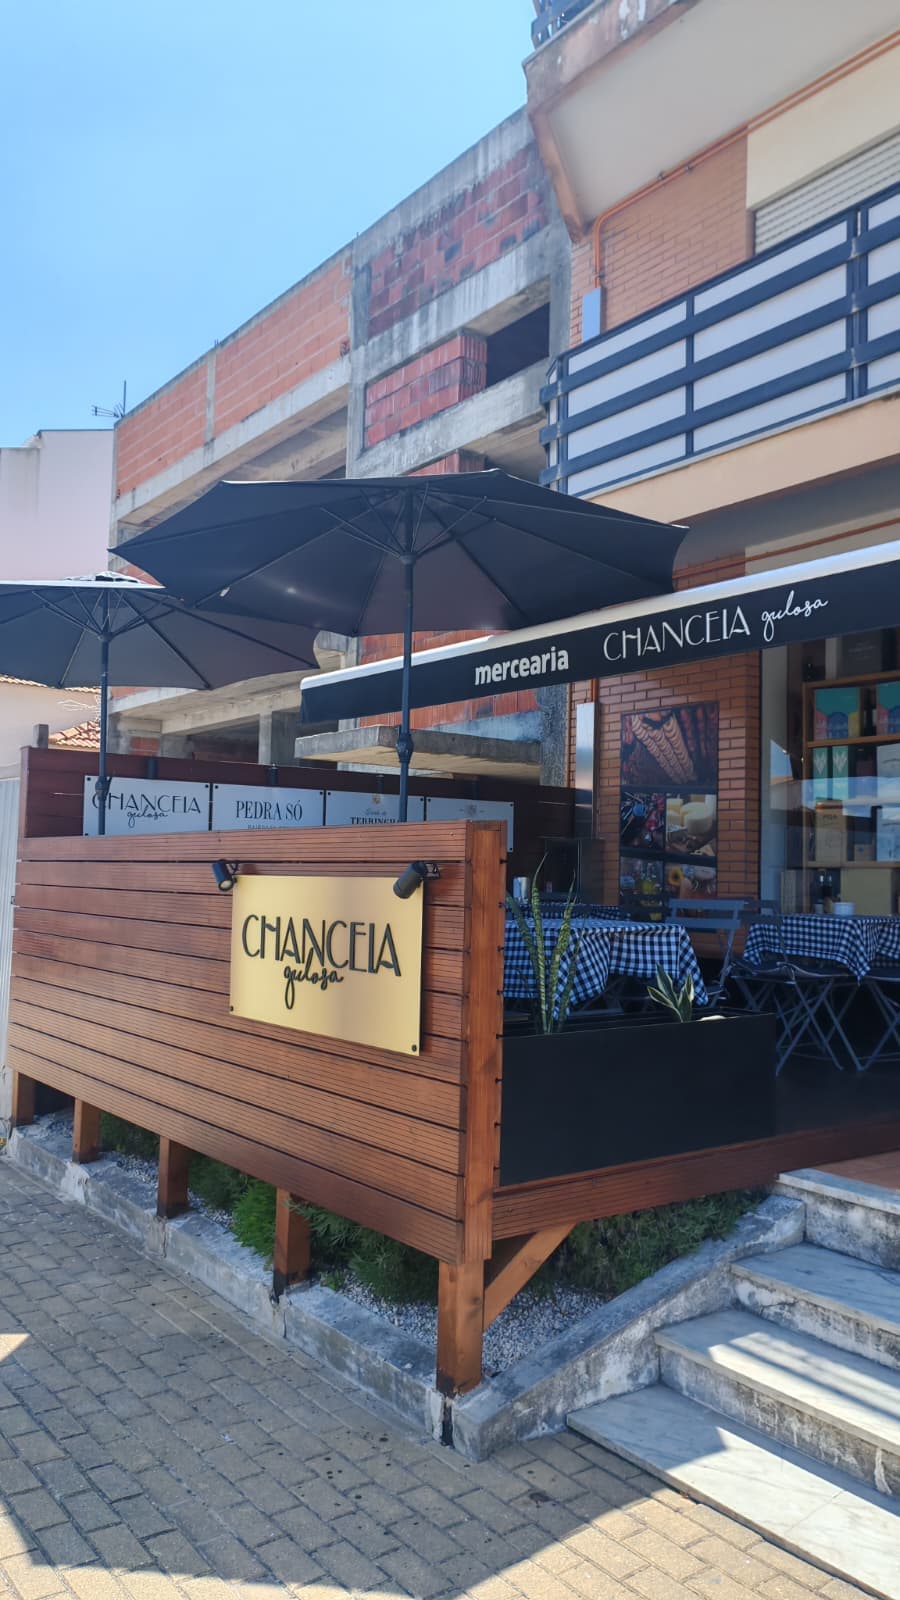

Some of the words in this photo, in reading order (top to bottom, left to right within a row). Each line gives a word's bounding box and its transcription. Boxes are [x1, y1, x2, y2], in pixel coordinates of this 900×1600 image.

[474, 646, 569, 686] mercearia
[761, 590, 829, 642] gulosa
[127, 803, 168, 828] gulosa
[236, 800, 282, 820] PEDRA
[285, 799, 303, 821] SÓ
[283, 947, 344, 1010] gulosa
